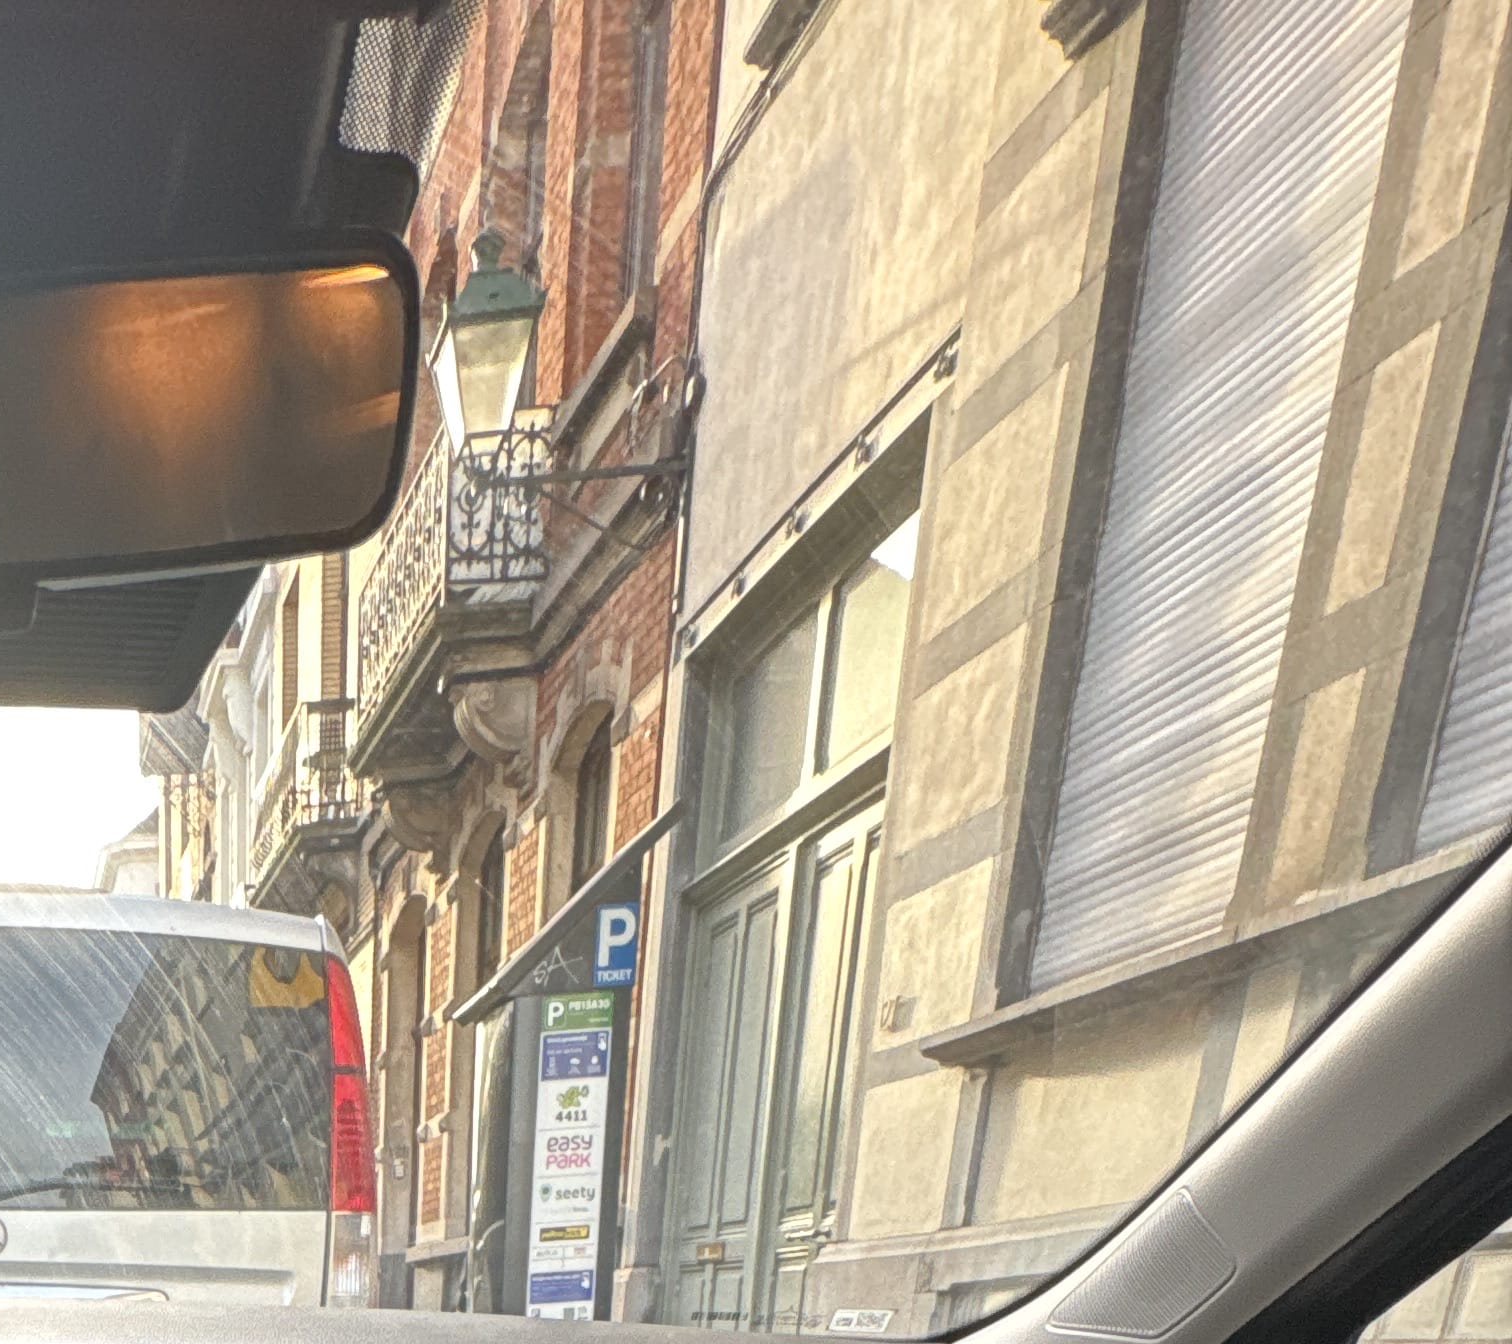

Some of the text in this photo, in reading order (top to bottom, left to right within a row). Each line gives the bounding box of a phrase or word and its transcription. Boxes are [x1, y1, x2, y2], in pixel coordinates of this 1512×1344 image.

[598, 907, 636, 967] P
[598, 969, 632, 983] TICKET
[548, 1001, 564, 1027] P
[555, 1109, 588, 1122] 4411
[547, 1134, 593, 1152] easy
[555, 1186, 595, 1201] seety
